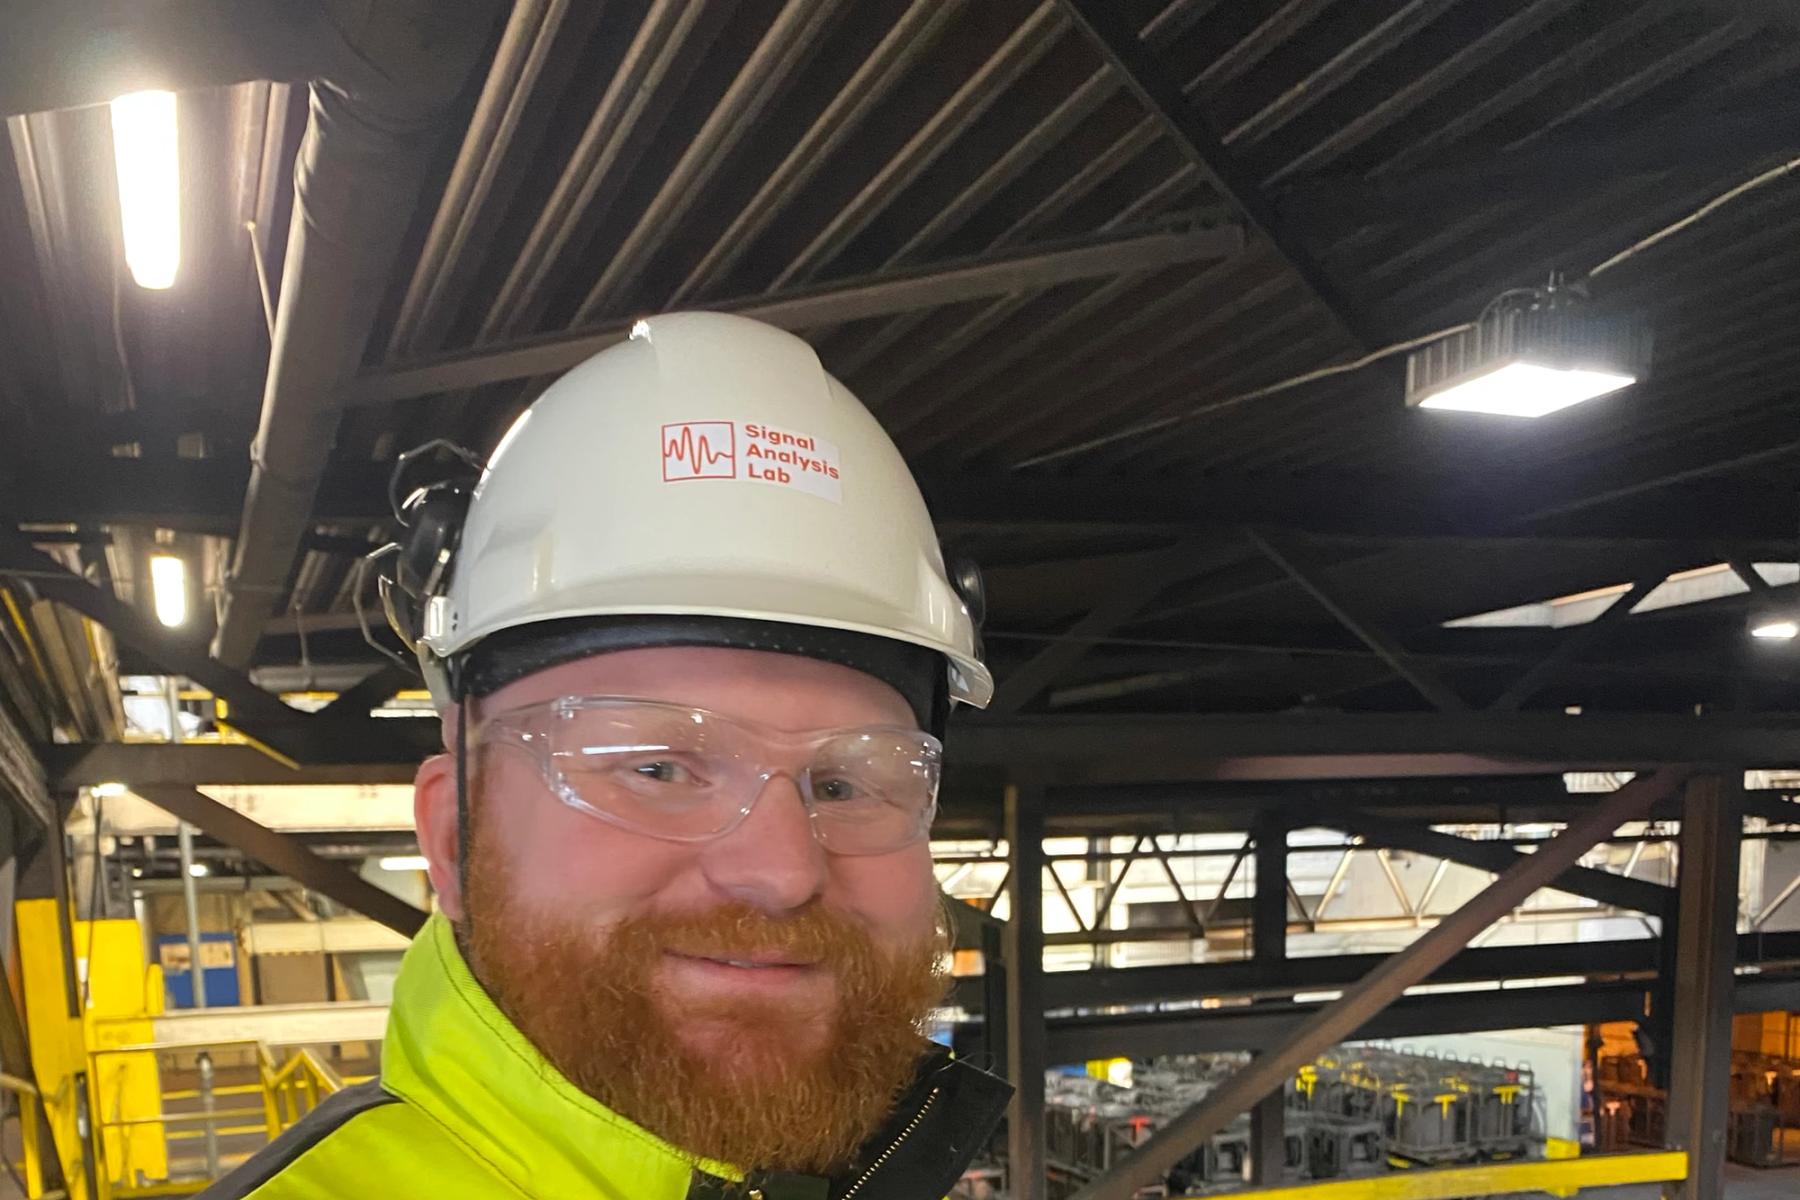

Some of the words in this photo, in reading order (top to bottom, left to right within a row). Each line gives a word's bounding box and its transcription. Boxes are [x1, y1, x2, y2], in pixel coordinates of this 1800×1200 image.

[745, 424, 815, 451] Signal
[746, 443, 839, 479] Analysis
[748, 463, 790, 484] Lab
